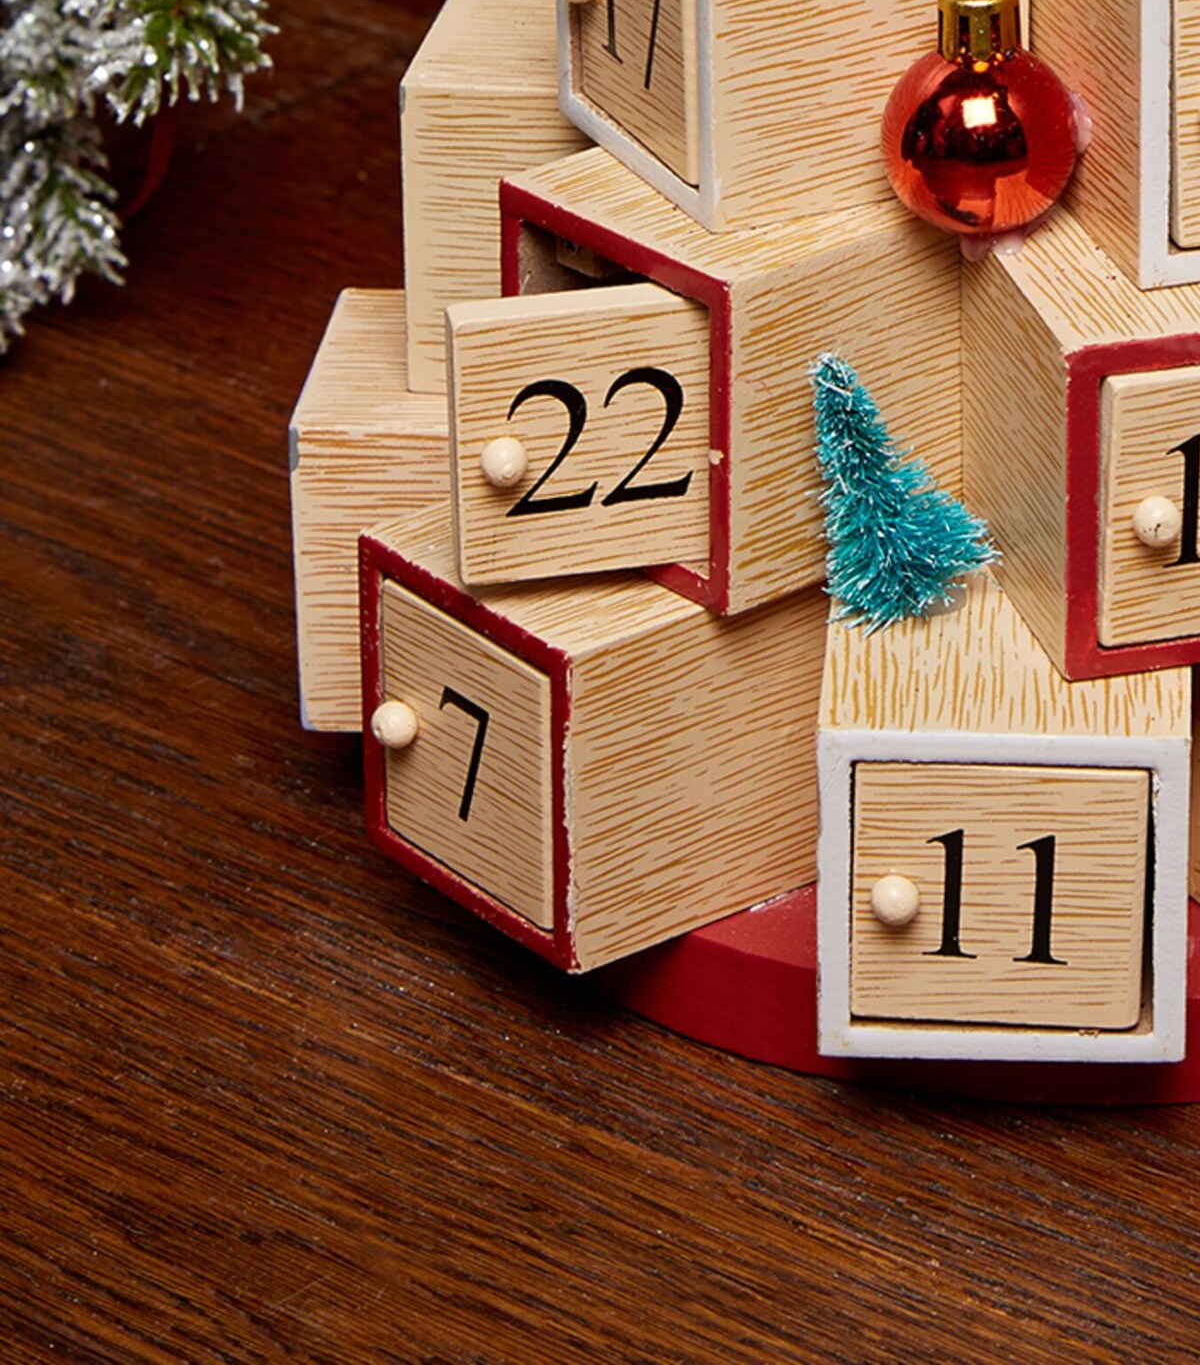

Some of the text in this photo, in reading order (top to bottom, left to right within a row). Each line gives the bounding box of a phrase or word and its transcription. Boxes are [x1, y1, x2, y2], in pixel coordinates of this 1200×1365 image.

[505, 366, 693, 518] 22
[439, 685, 490, 823] 7
[922, 829, 1068, 965] 11
